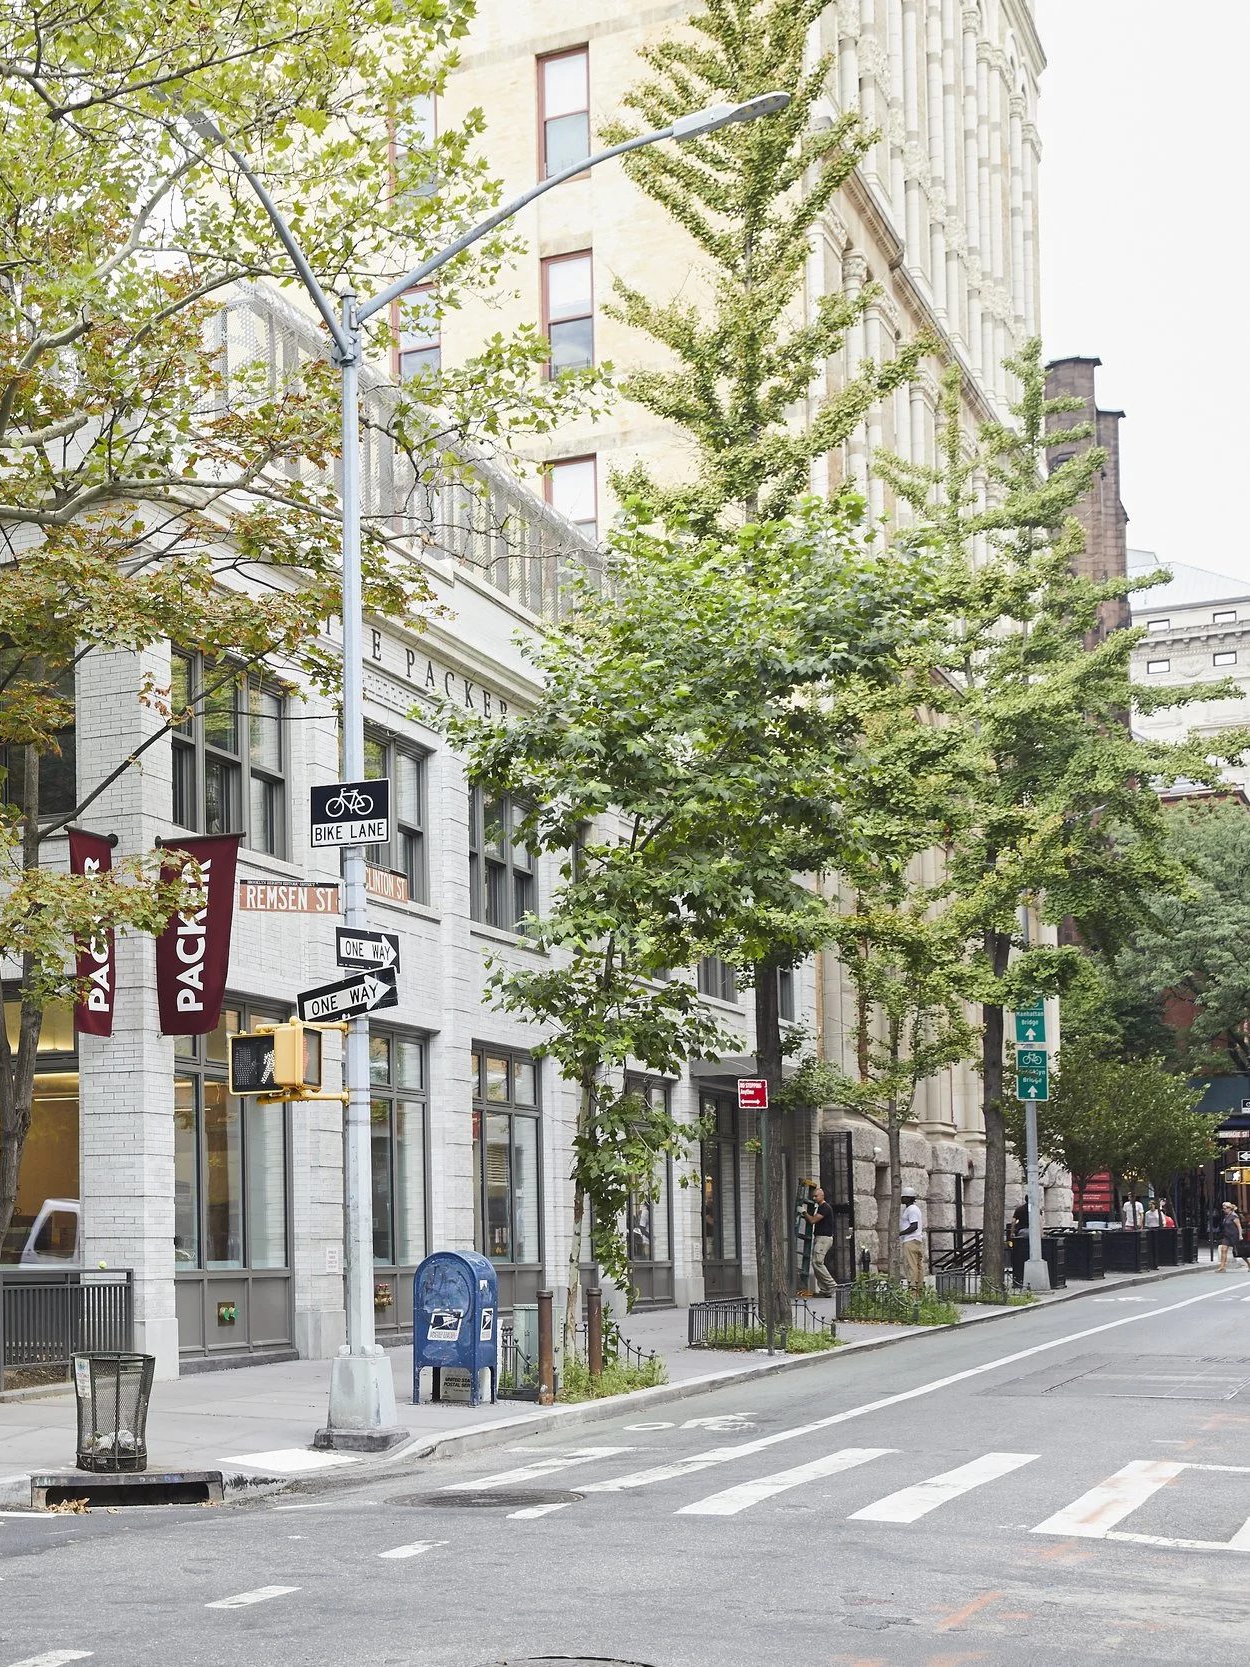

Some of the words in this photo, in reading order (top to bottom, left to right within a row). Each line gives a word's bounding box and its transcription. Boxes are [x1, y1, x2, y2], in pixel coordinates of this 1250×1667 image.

[315, 825, 343, 842] BIKE
[350, 822, 384, 839] LANE
[246, 885, 308, 910] REMSEN
[316, 887, 334, 911] ST
[397, 876, 406, 901] ST
[84, 856, 110, 1012] PACR
[345, 940, 364, 957] ONE
[372, 944, 391, 961] WAY
[311, 995, 338, 1016] ONE
[350, 982, 378, 1004] WAY
